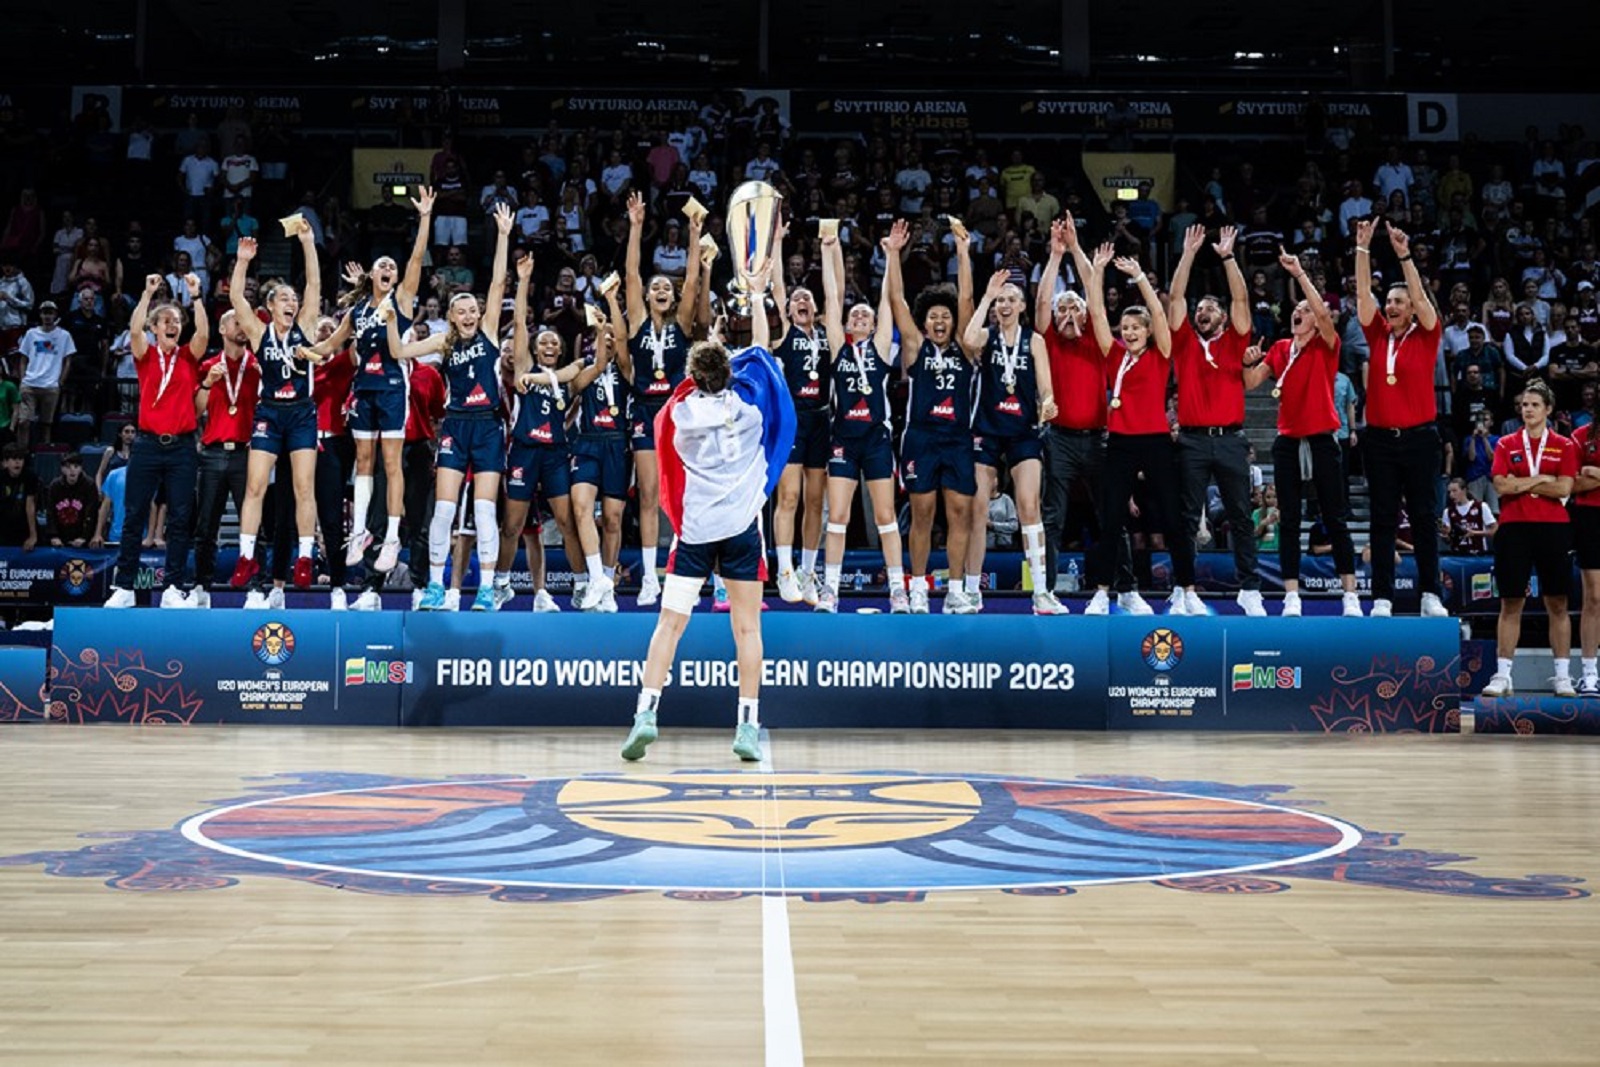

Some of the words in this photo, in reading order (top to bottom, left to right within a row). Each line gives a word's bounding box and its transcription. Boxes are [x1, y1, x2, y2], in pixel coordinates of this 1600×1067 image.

[646, 98, 699, 111] ARENA
[914, 100, 968, 113] ARENA
[1418, 102, 1447, 133] D
[935, 373, 956, 390] 32
[541, 399, 550, 415] 5
[437, 658, 492, 686] FIBA
[499, 658, 548, 687] U20
[680, 659, 809, 688] EUROEAN
[817, 660, 1002, 690] CHAMPIONSHIP
[1009, 662, 1075, 690] 2023
[217, 679, 235, 691] U20
[237, 680, 281, 691] WOMEN'S
[282, 680, 329, 692] EUROPEAN
[1108, 686, 1126, 697] U20
[1128, 686, 1169, 698] WOMEN'S
[1170, 687, 1217, 698] EUROPEAN
[239, 691, 307, 703] CHAMPIONSHIP
[1130, 697, 1195, 709] CHAMPIONSHIP
